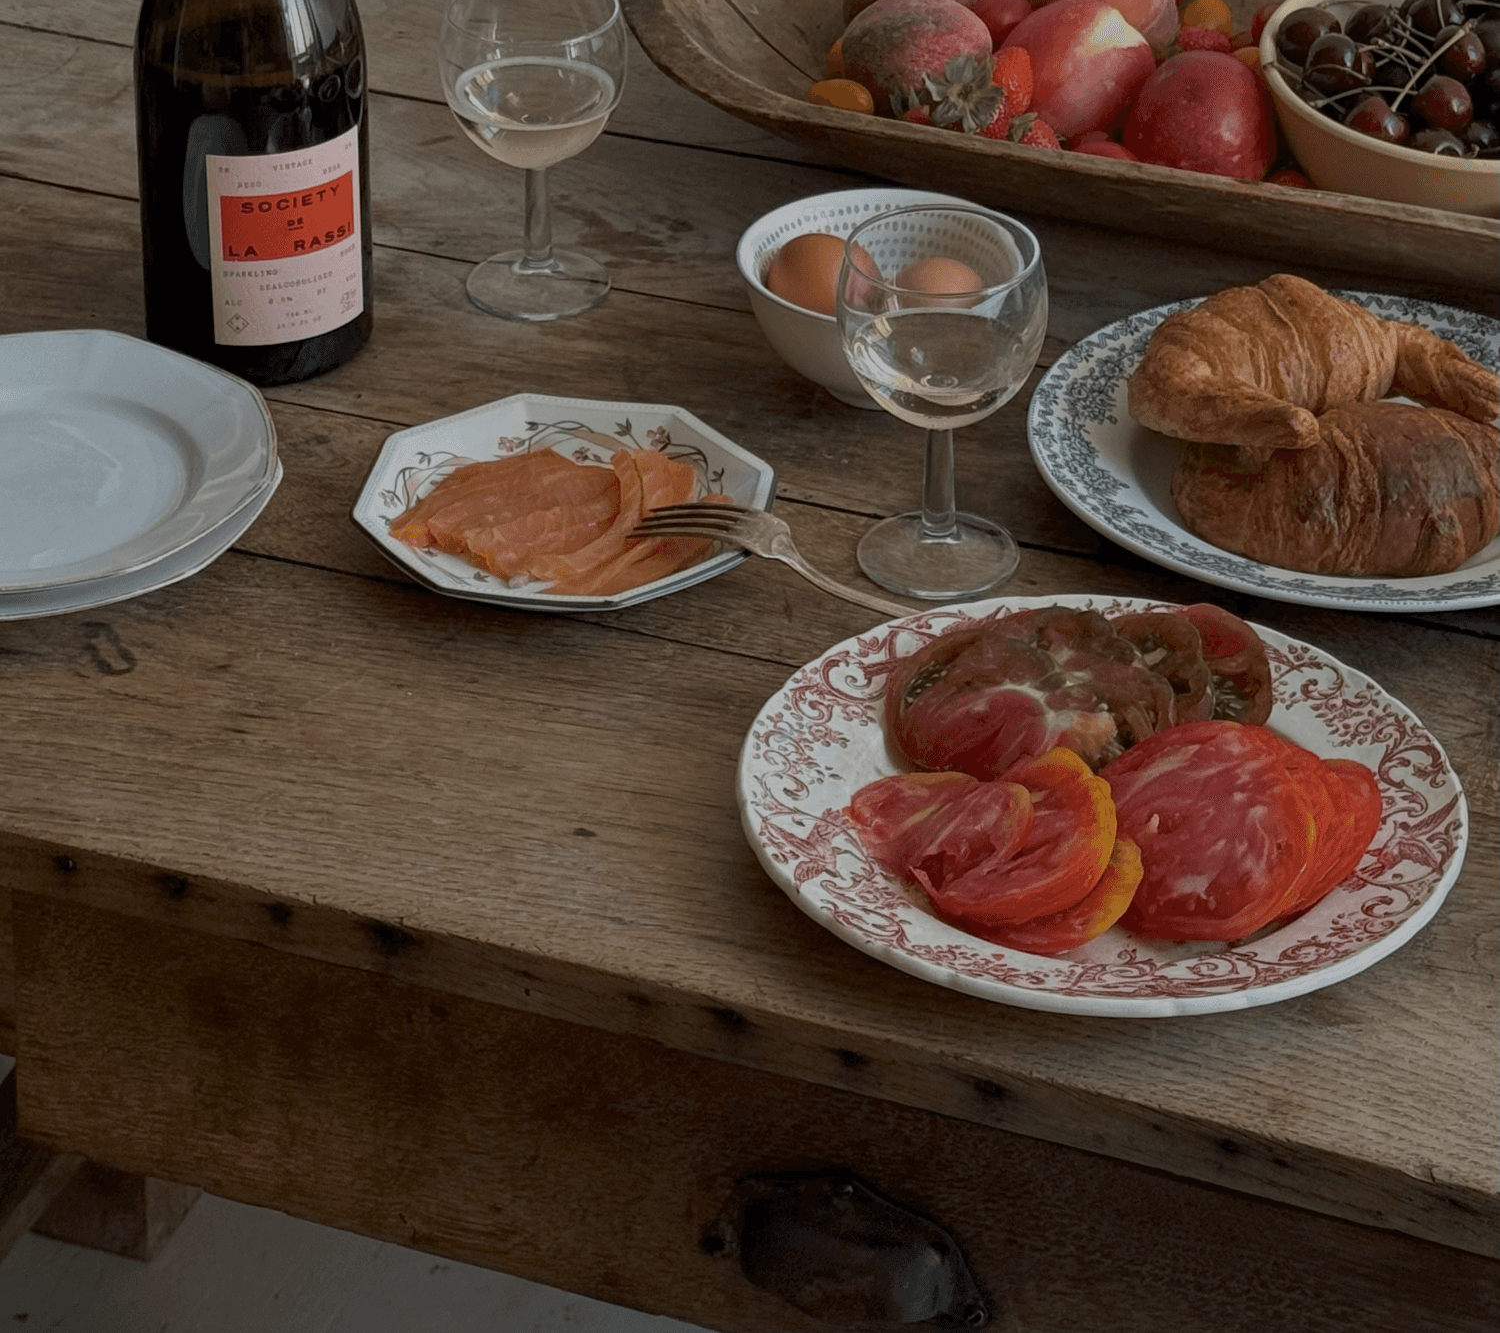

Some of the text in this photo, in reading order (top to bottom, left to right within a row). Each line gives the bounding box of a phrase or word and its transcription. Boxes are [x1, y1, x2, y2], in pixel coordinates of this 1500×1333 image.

[272, 158, 313, 172] VINTAGE
[241, 184, 340, 214] SOCIETY
[287, 217, 304, 227] DE
[228, 221, 352, 258] LA RASSI
[222, 269, 279, 278] SPARKLING
[224, 299, 243, 307] ALC
